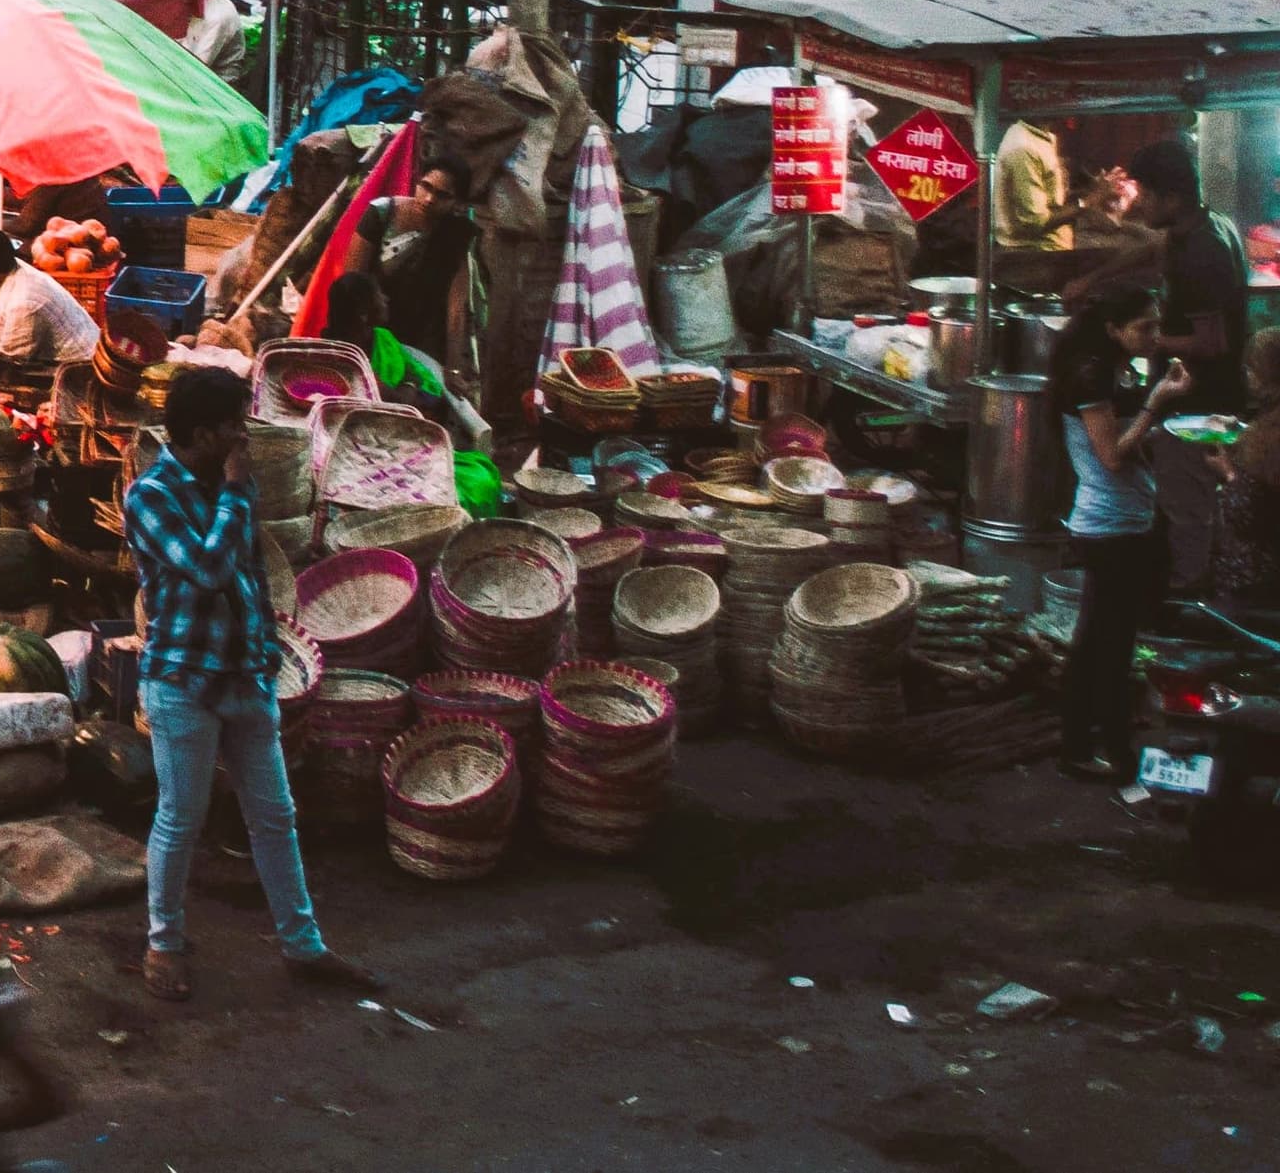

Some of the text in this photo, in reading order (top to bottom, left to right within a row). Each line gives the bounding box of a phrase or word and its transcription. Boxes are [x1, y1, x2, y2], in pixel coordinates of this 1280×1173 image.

[906, 124, 945, 150] लोणी
[877, 150, 968, 180] मसाला डोसा
[908, 174, 946, 203] 20/-
